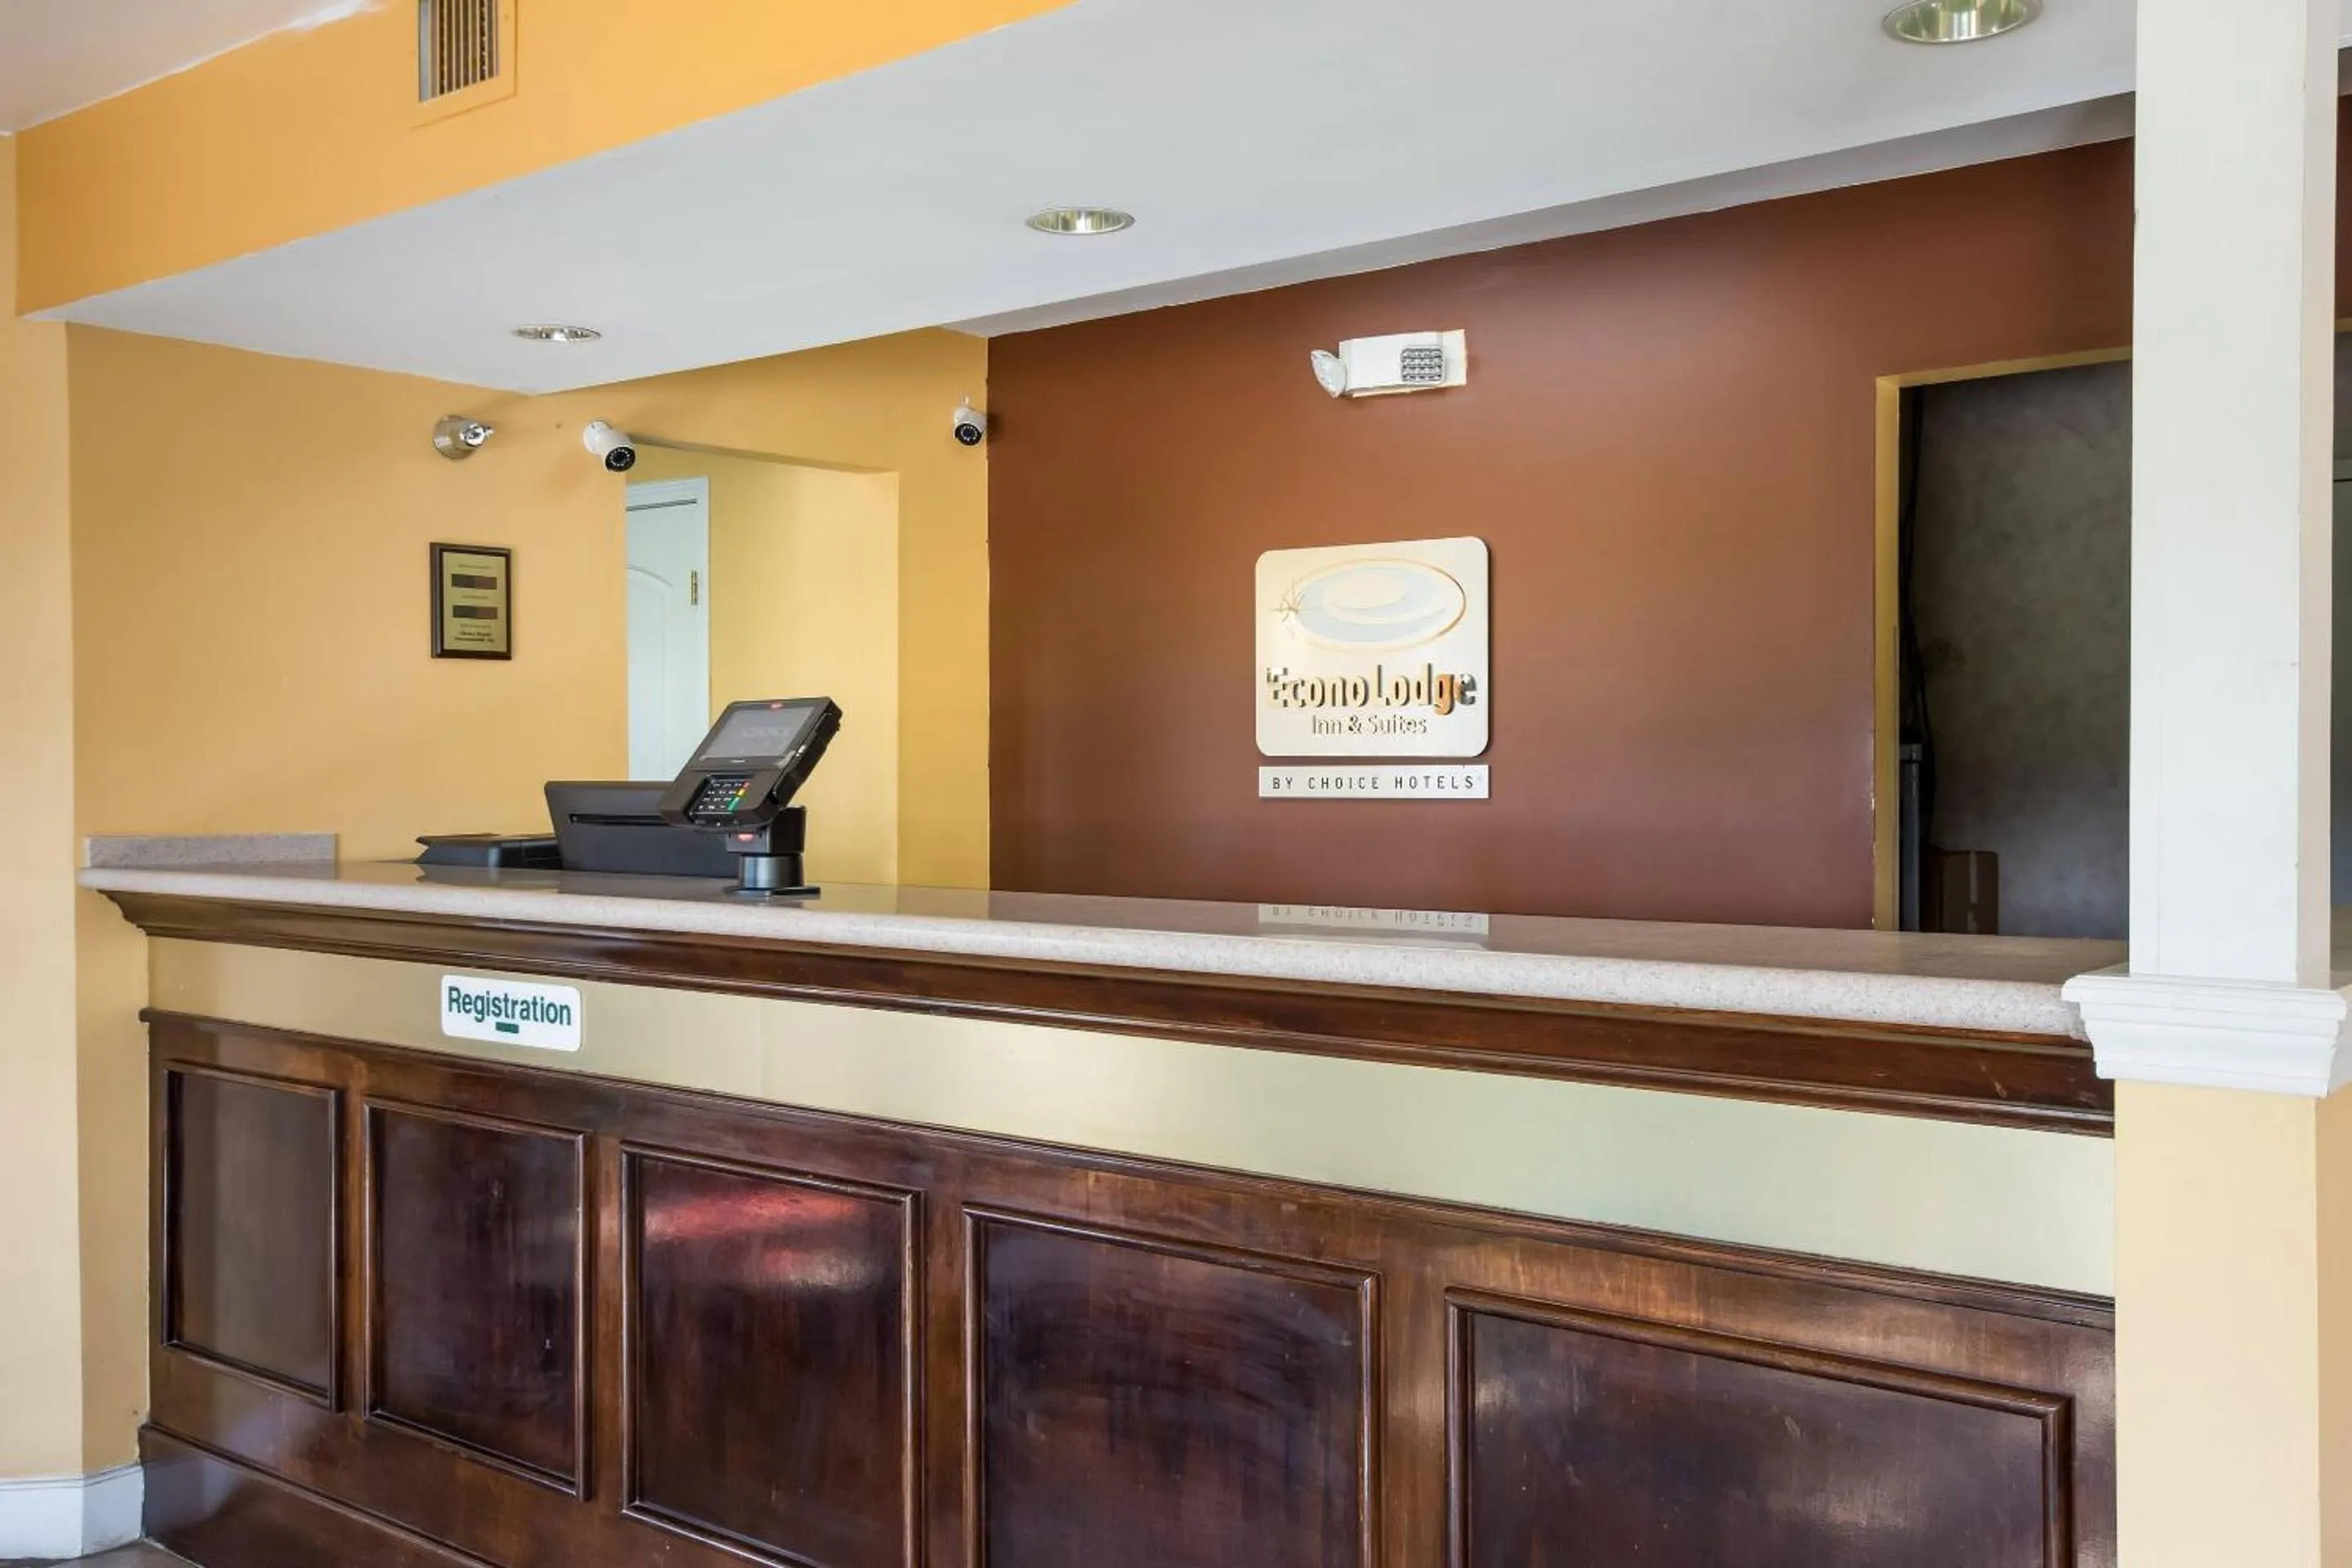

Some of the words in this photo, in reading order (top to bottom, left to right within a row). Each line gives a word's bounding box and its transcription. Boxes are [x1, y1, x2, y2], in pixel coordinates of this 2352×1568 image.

[1312, 715, 1342, 734] Inn
[1348, 715, 1362, 734] &
[1367, 715, 1428, 734] Suites
[1272, 777, 1294, 790] BY
[1307, 777, 1380, 790] CHOICE
[1394, 775, 1474, 790] HOTELS
[448, 986, 572, 1026] Registration
